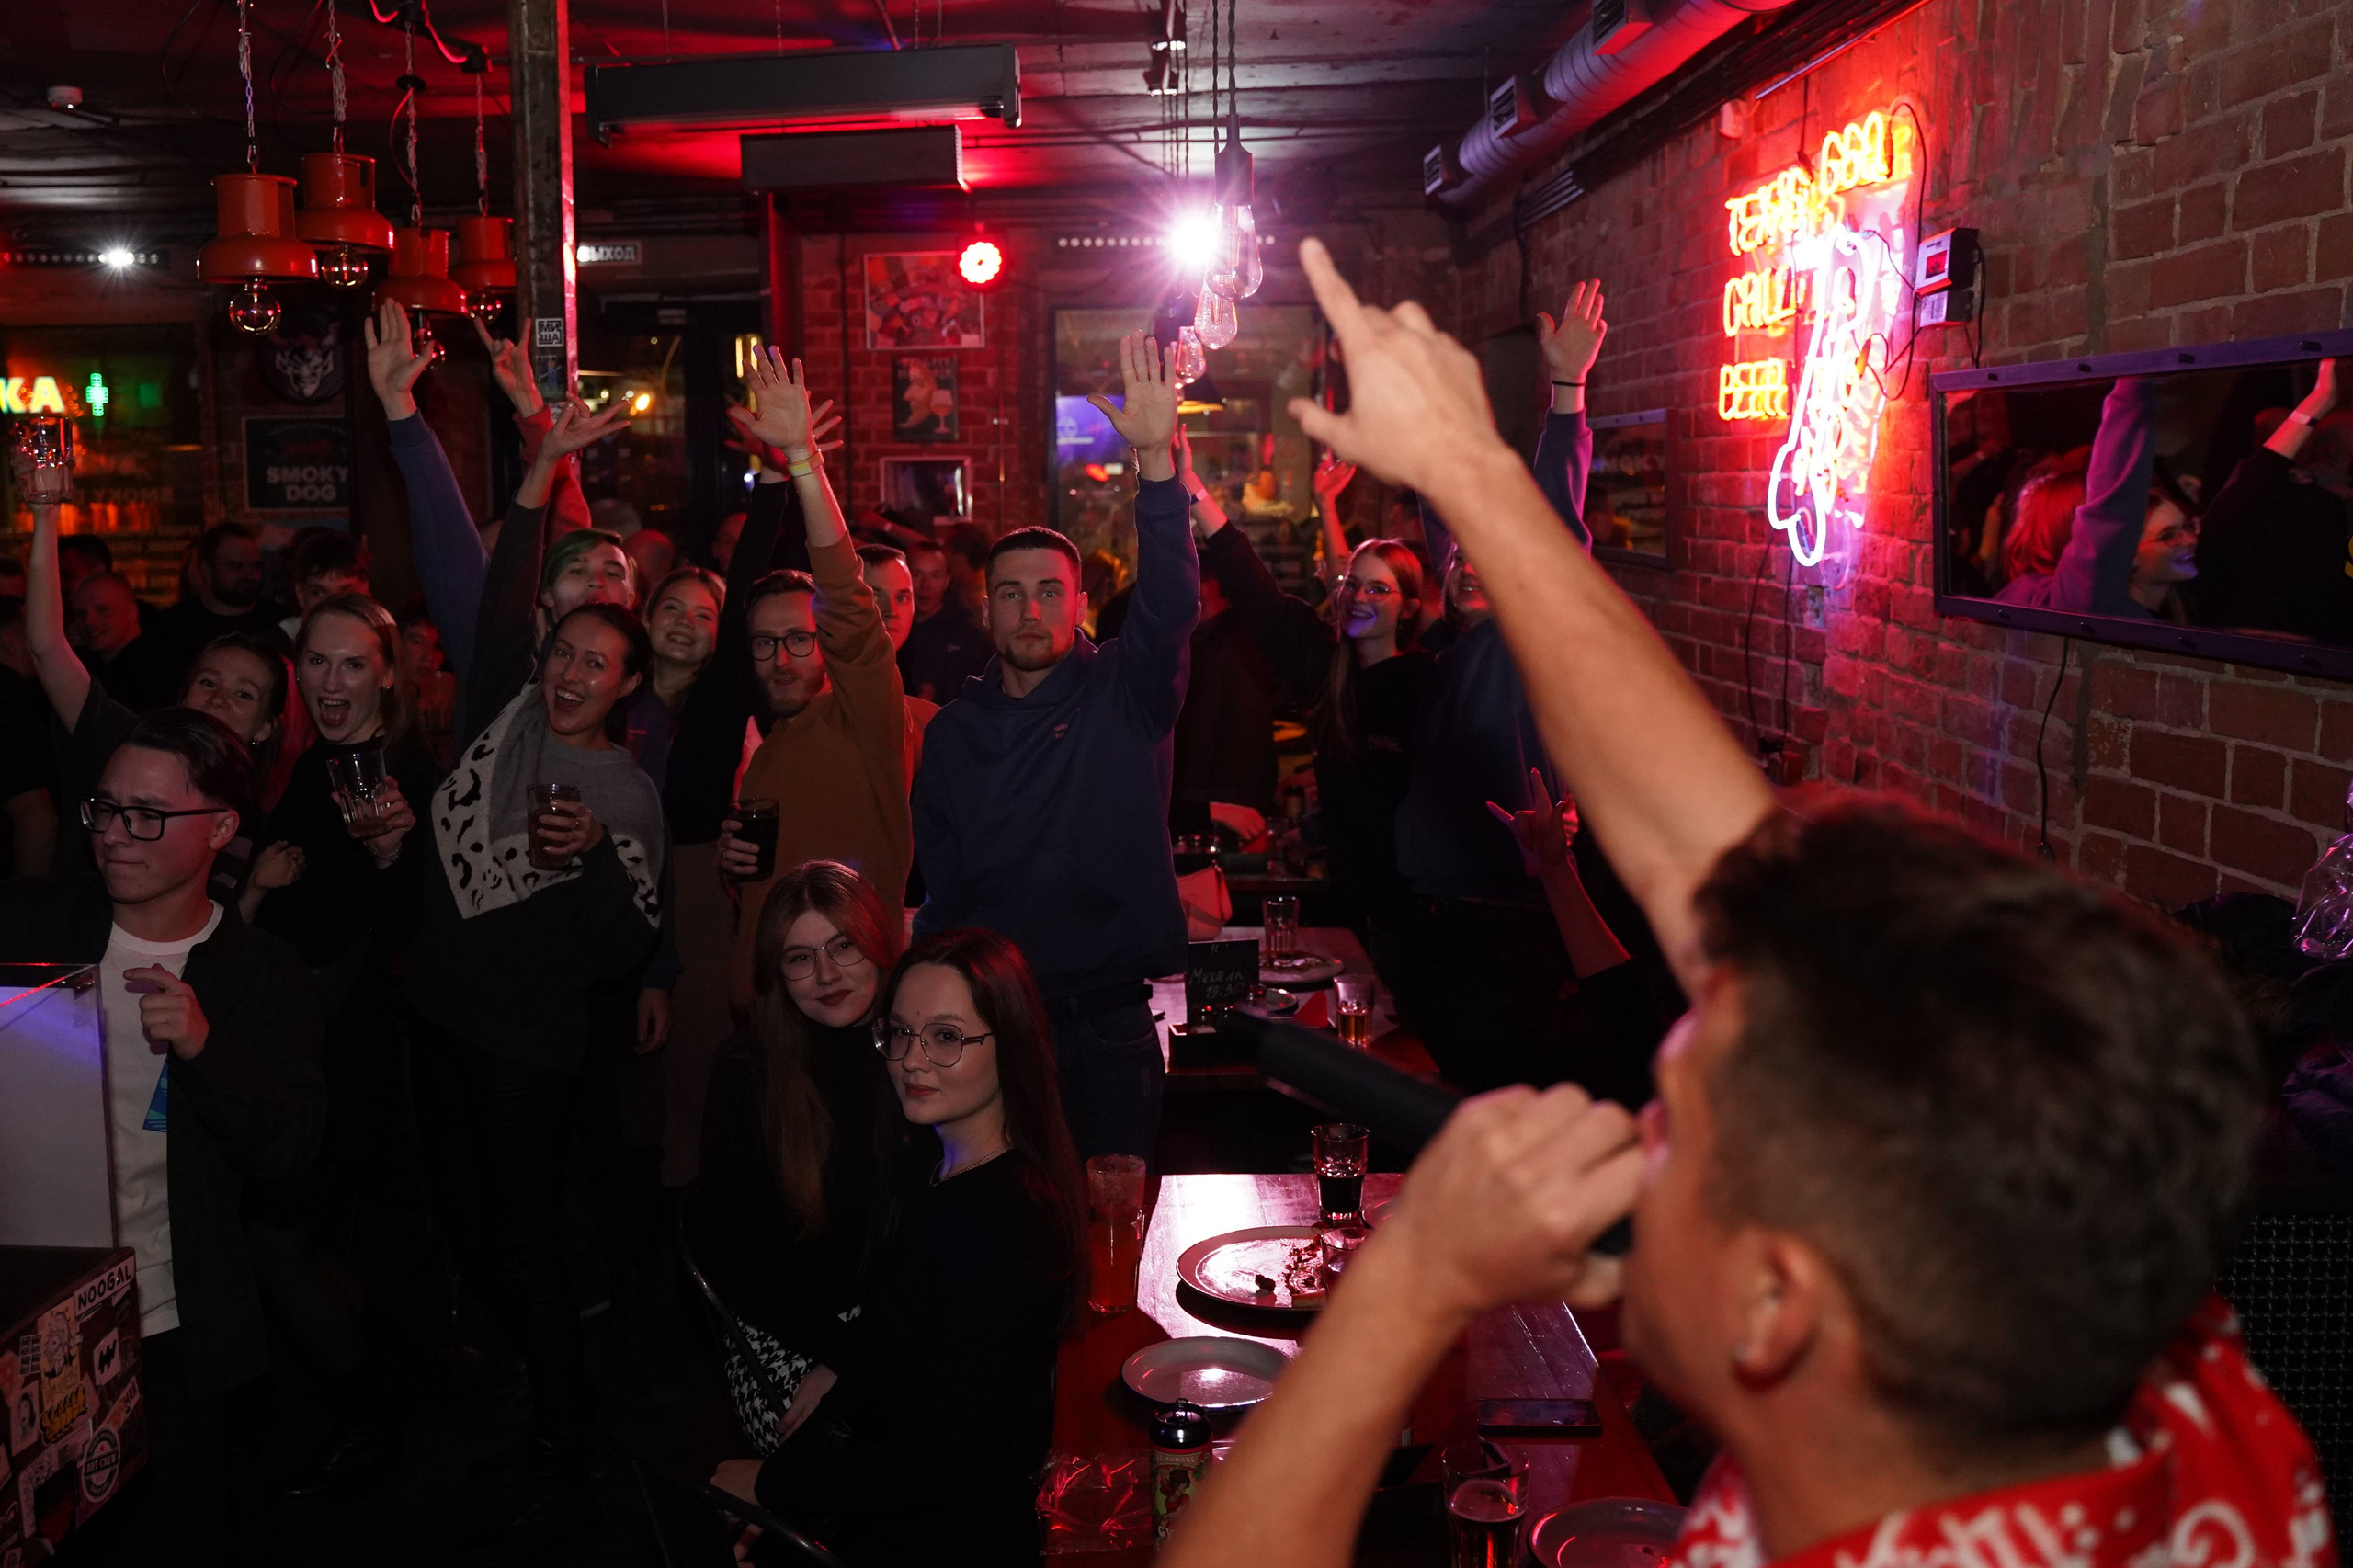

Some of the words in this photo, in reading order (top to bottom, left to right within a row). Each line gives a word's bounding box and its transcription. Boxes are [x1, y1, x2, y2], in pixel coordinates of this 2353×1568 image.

[577, 245, 636, 263] ЫХОД
[1719, 358, 1789, 420] BEER
[266, 465, 348, 484] SMOKY
[286, 483, 337, 502] DOG
[78, 1265, 131, 1311] NOOGAL
